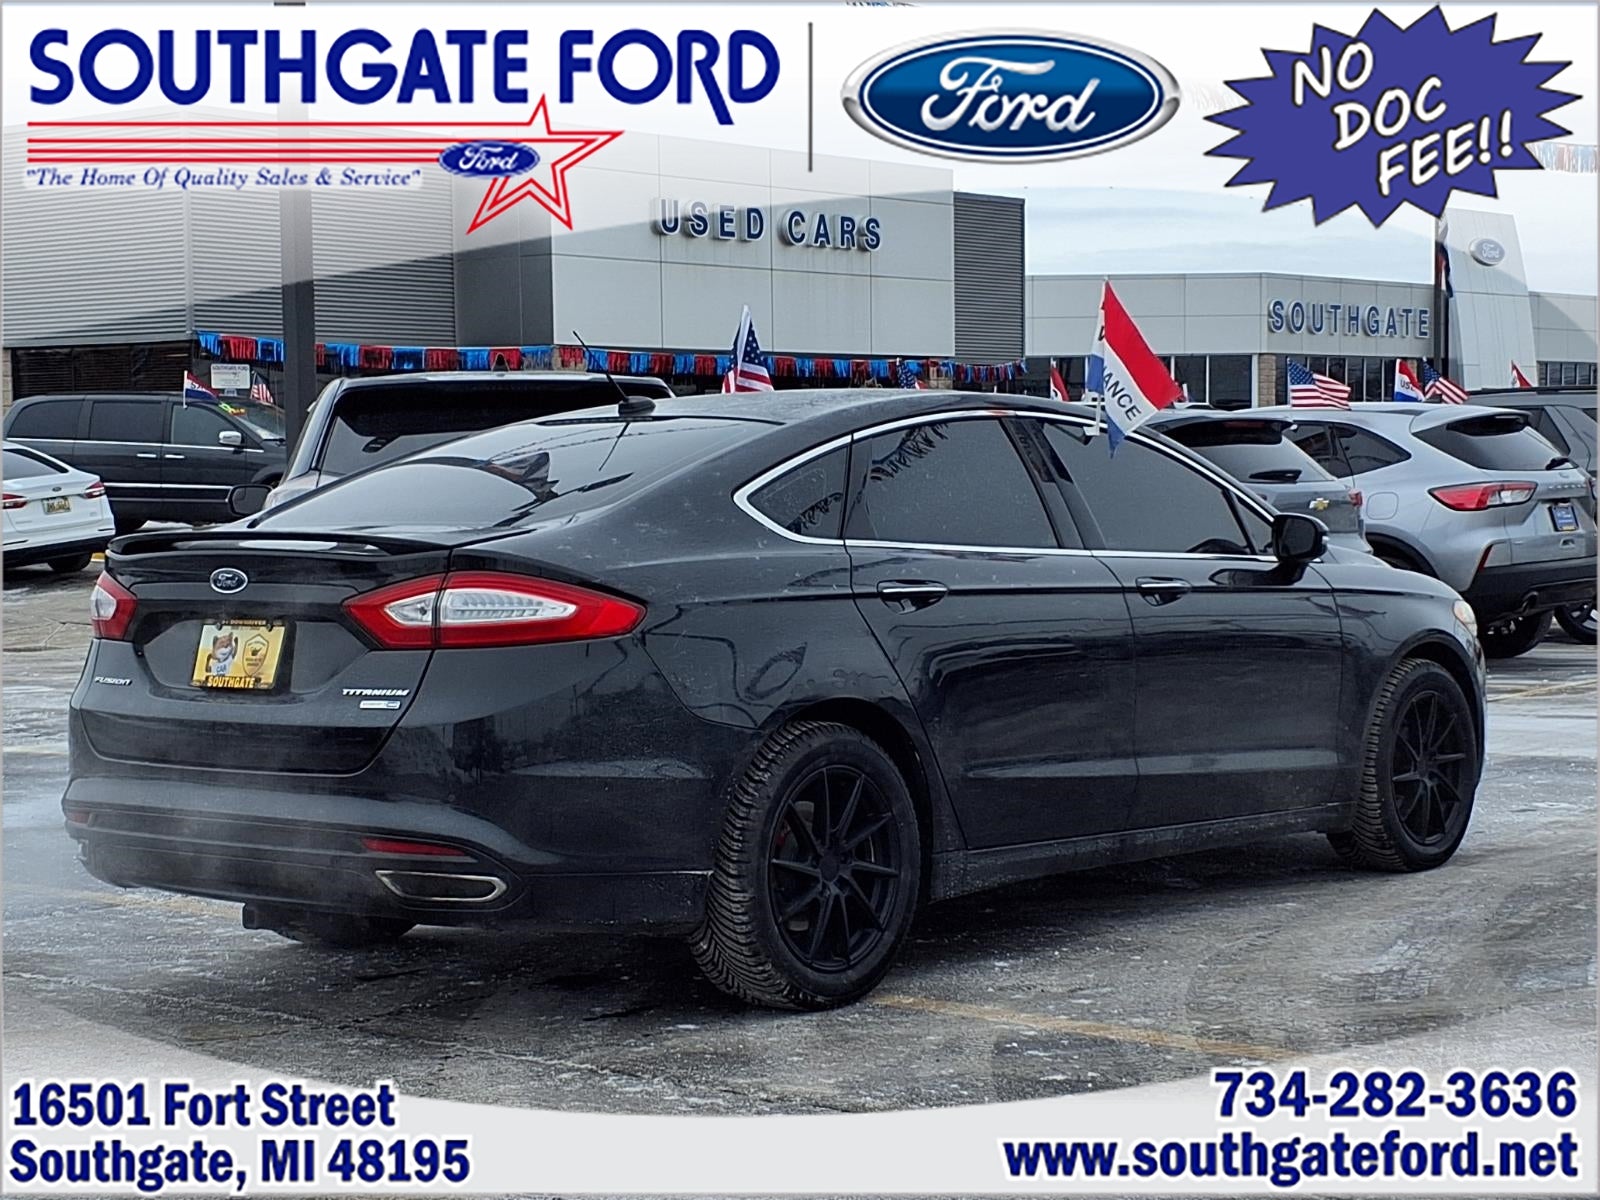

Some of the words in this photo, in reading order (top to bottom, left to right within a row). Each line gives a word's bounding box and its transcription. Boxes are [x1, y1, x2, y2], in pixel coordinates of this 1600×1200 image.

[660, 198, 766, 242] USED
[787, 209, 880, 251] CARS
[1270, 300, 1429, 338] SOUTHGATE
[94, 676, 132, 686] FUSION
[207, 675, 256, 688] SOUTHGATE
[342, 688, 410, 696] TITANIUM
